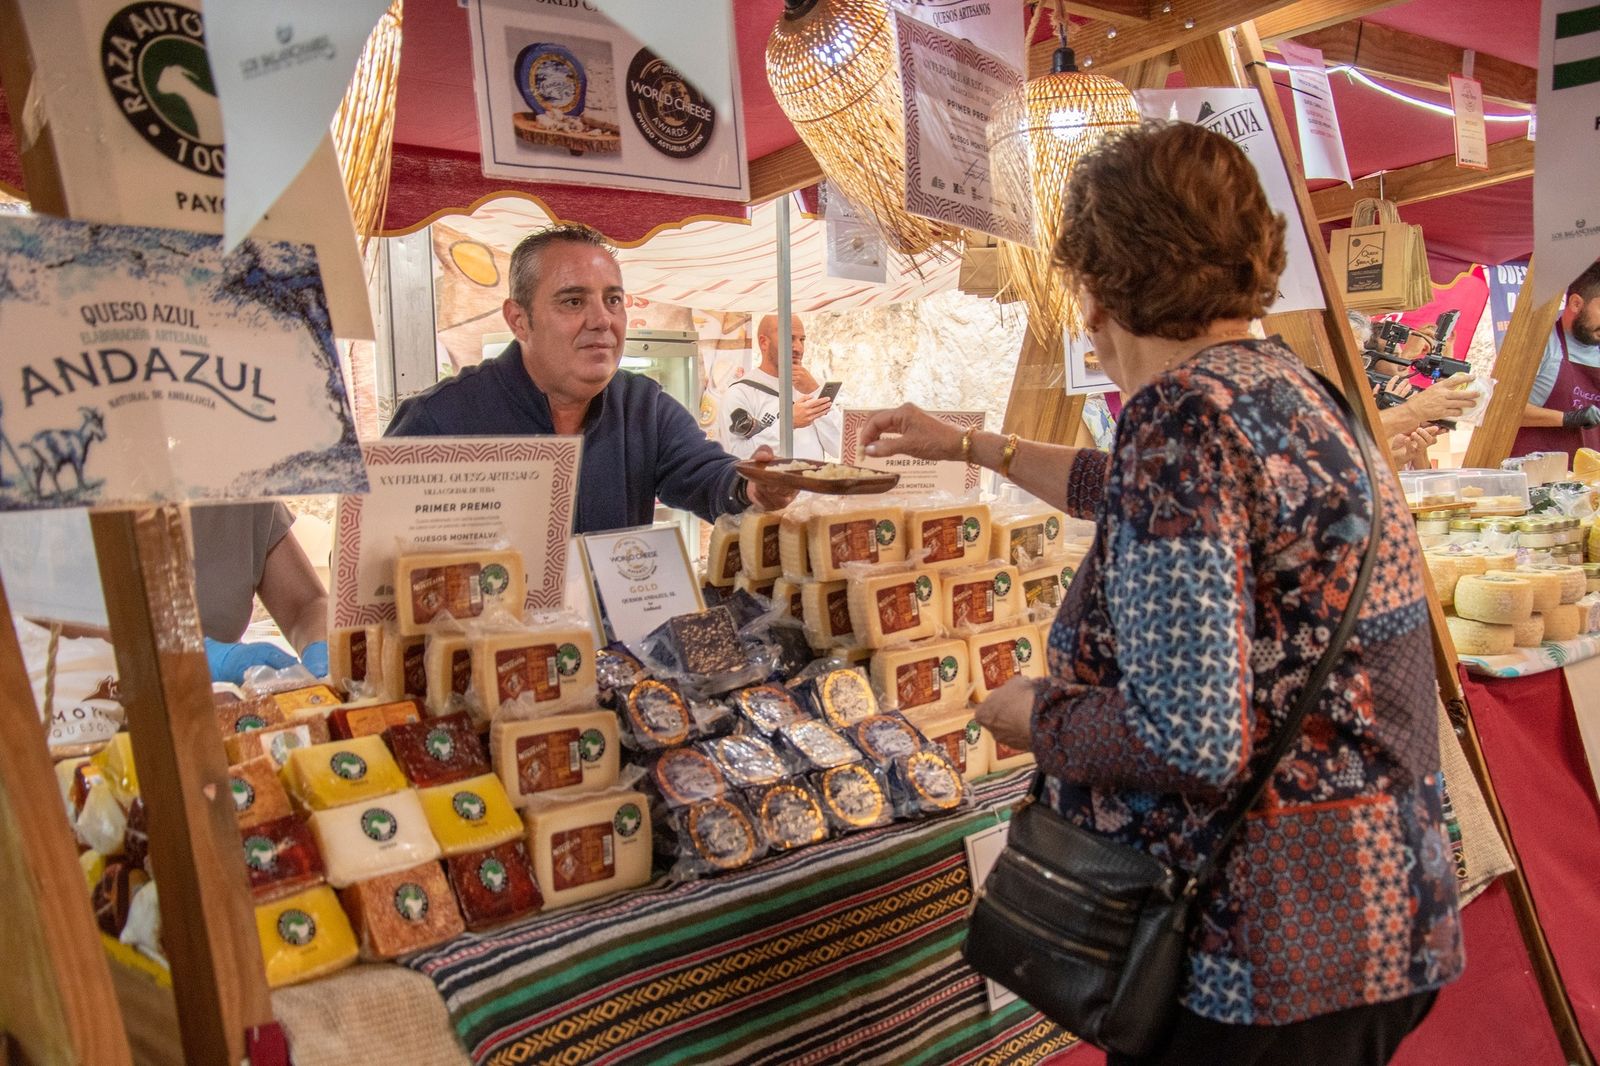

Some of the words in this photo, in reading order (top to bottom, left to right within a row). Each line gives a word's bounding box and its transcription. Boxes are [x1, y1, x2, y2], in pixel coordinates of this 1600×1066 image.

[933, 9, 958, 27] QUESOS
[959, 3, 991, 20] ARTESANOS
[107, 35, 147, 114] RAZA
[631, 80, 673, 105] WORLD
[674, 98, 711, 122] CHEESE
[947, 99, 971, 115] PRIMER
[972, 109, 992, 121] PREM
[636, 112, 655, 139] OVIEDO
[657, 139, 687, 152] ASTURIAS
[652, 116, 688, 137] AWARDS
[80, 301, 147, 327] QUESO
[152, 303, 200, 329] AZUL
[20, 347, 277, 422] ANDAZUL
[912, 459, 938, 467] PREMIO
[415, 503, 457, 514] PRIMER
[460, 501, 502, 513] PREMIO
[413, 534, 447, 544] QUESOS
[630, 583, 658, 594] GOLD
